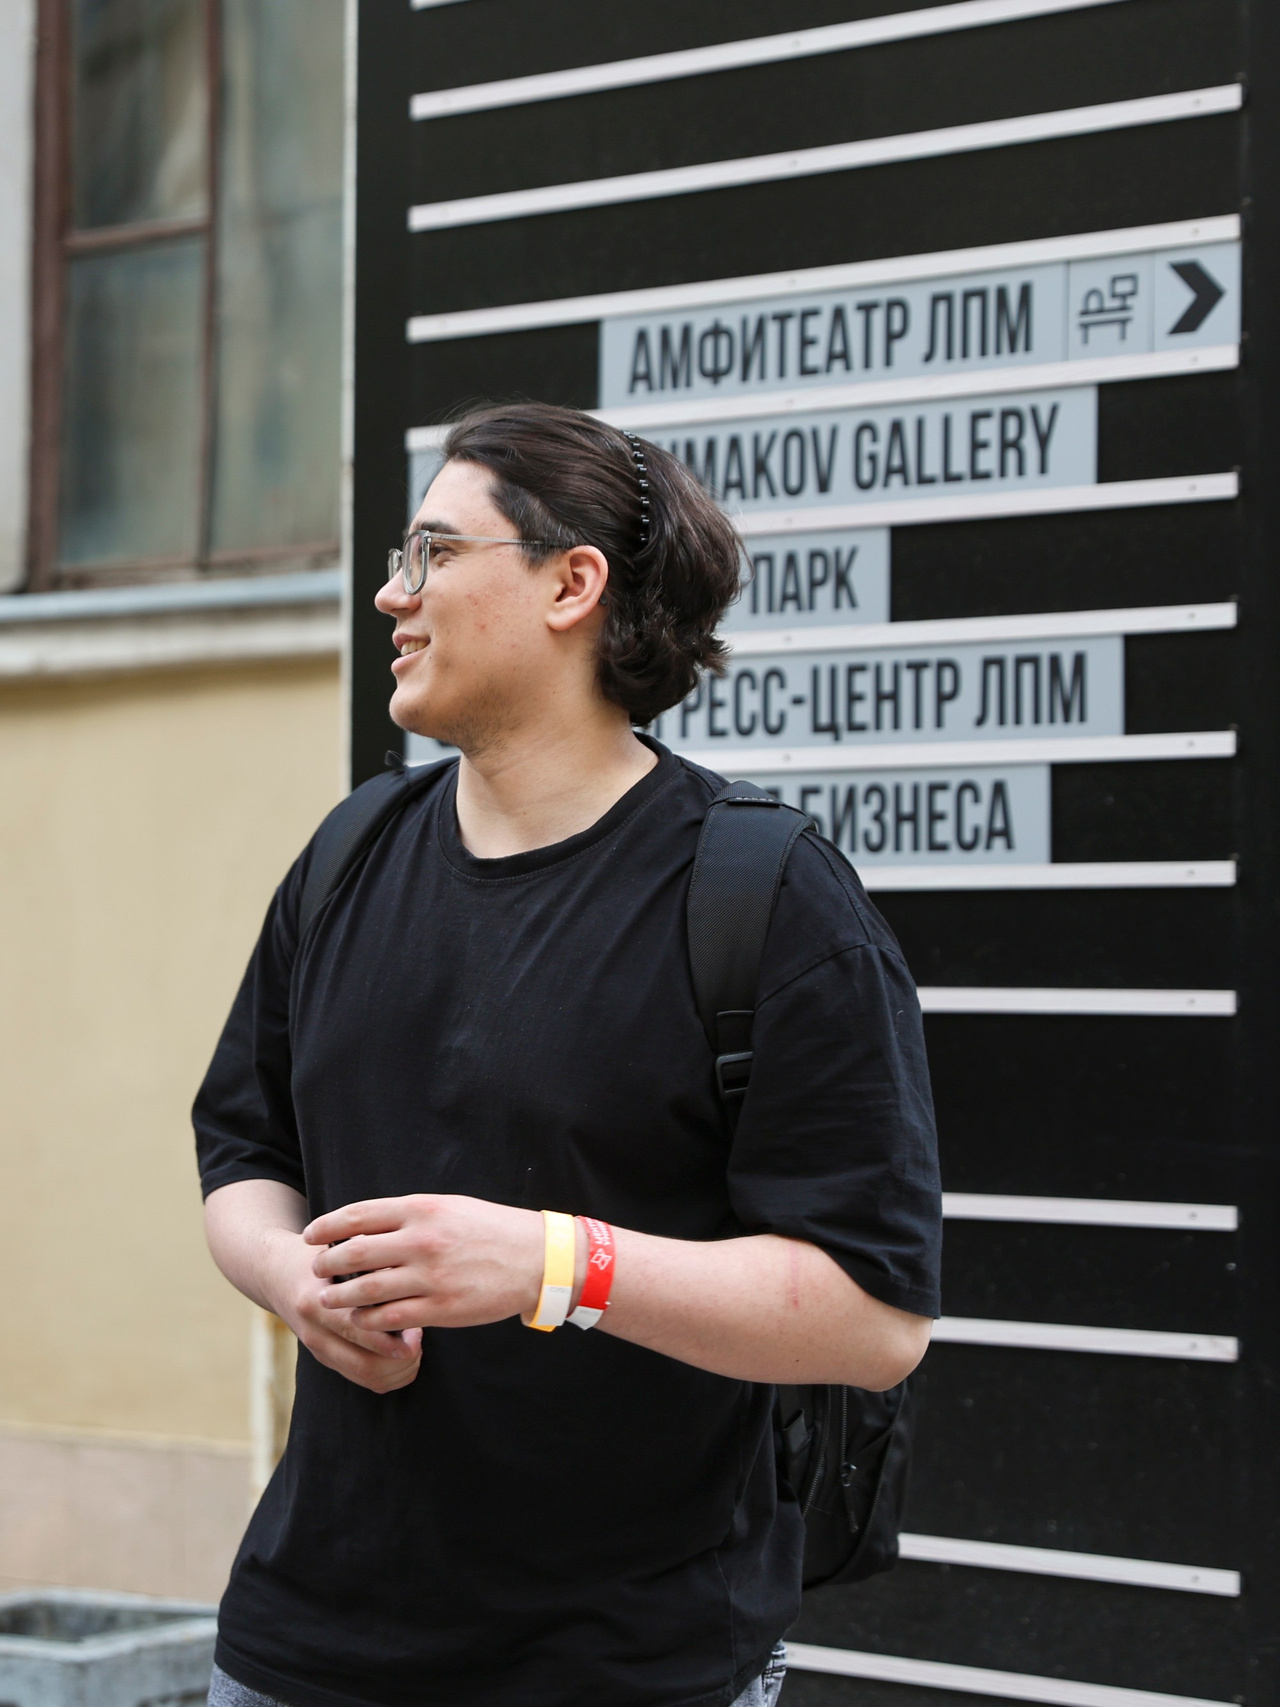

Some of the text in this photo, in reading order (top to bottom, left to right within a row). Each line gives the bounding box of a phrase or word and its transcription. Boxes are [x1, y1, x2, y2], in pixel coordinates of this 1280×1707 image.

[628, 281, 1034, 395] АМФИТЕАТР ЛПМ
[656, 402, 1061, 502] MAKOV GALLERY
[743, 544, 860, 615] ПАРК
[654, 651, 1089, 742] РЕСС-ЦЕНТР ЛПМ
